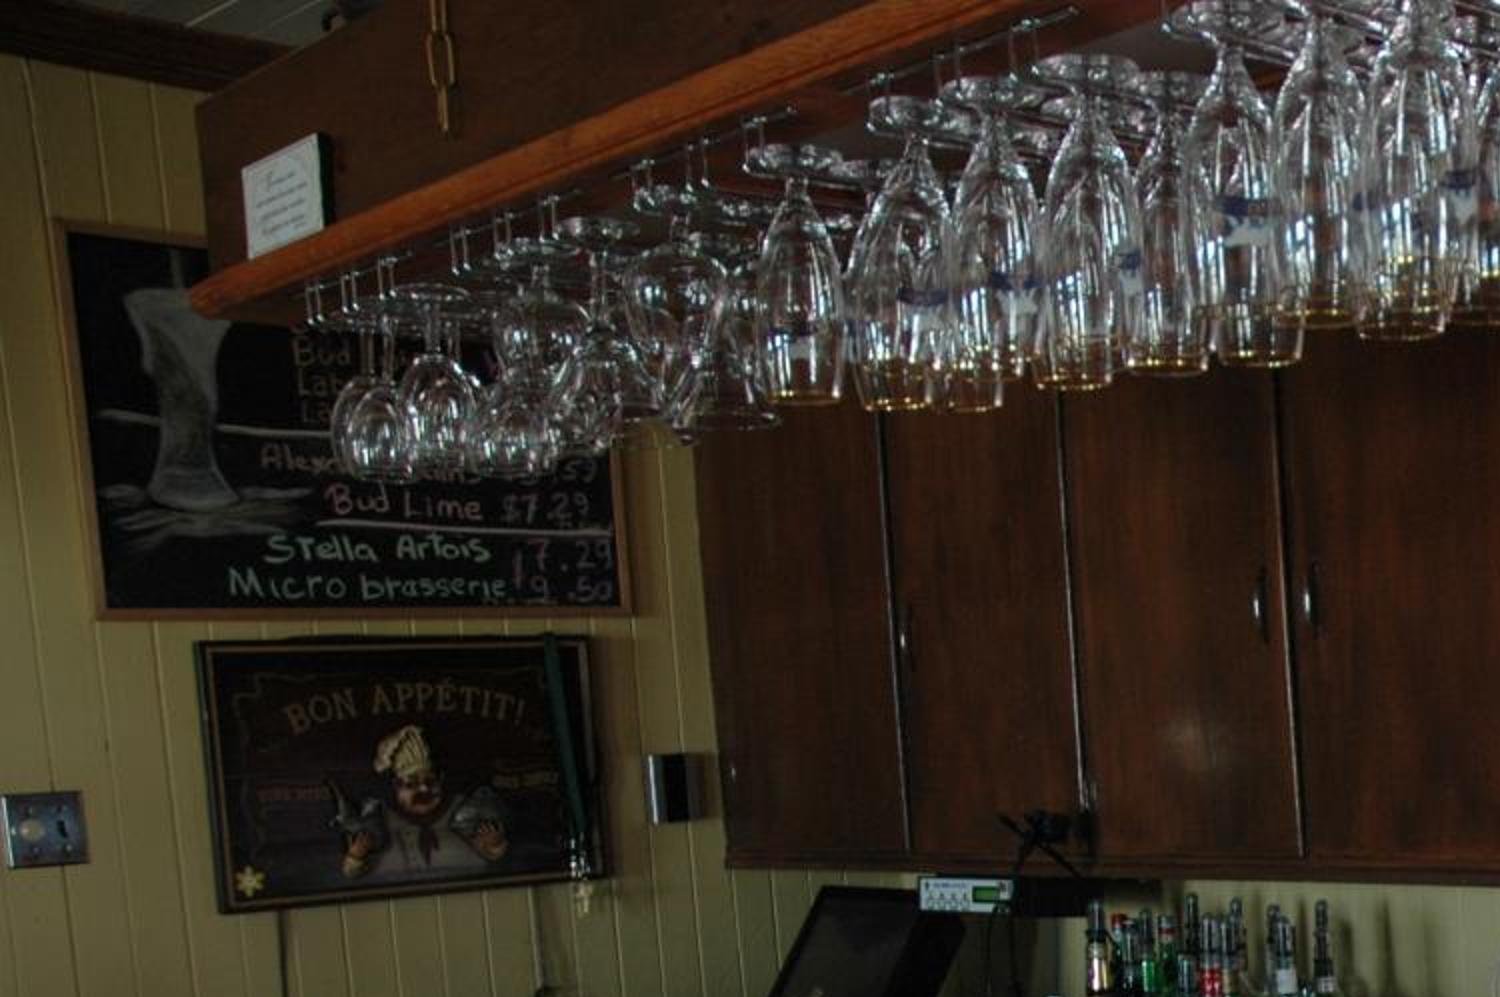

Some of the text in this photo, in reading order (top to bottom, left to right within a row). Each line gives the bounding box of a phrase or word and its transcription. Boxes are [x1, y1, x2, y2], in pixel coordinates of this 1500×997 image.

[322, 480, 392, 516] Bud
[403, 488, 485, 521] Lime
[263, 533, 379, 565] Stella
[396, 531, 492, 562] Artois
[226, 566, 347, 601] Micro
[359, 571, 508, 602] brasserie
[283, 676, 526, 735] BON APPÉTIT!
